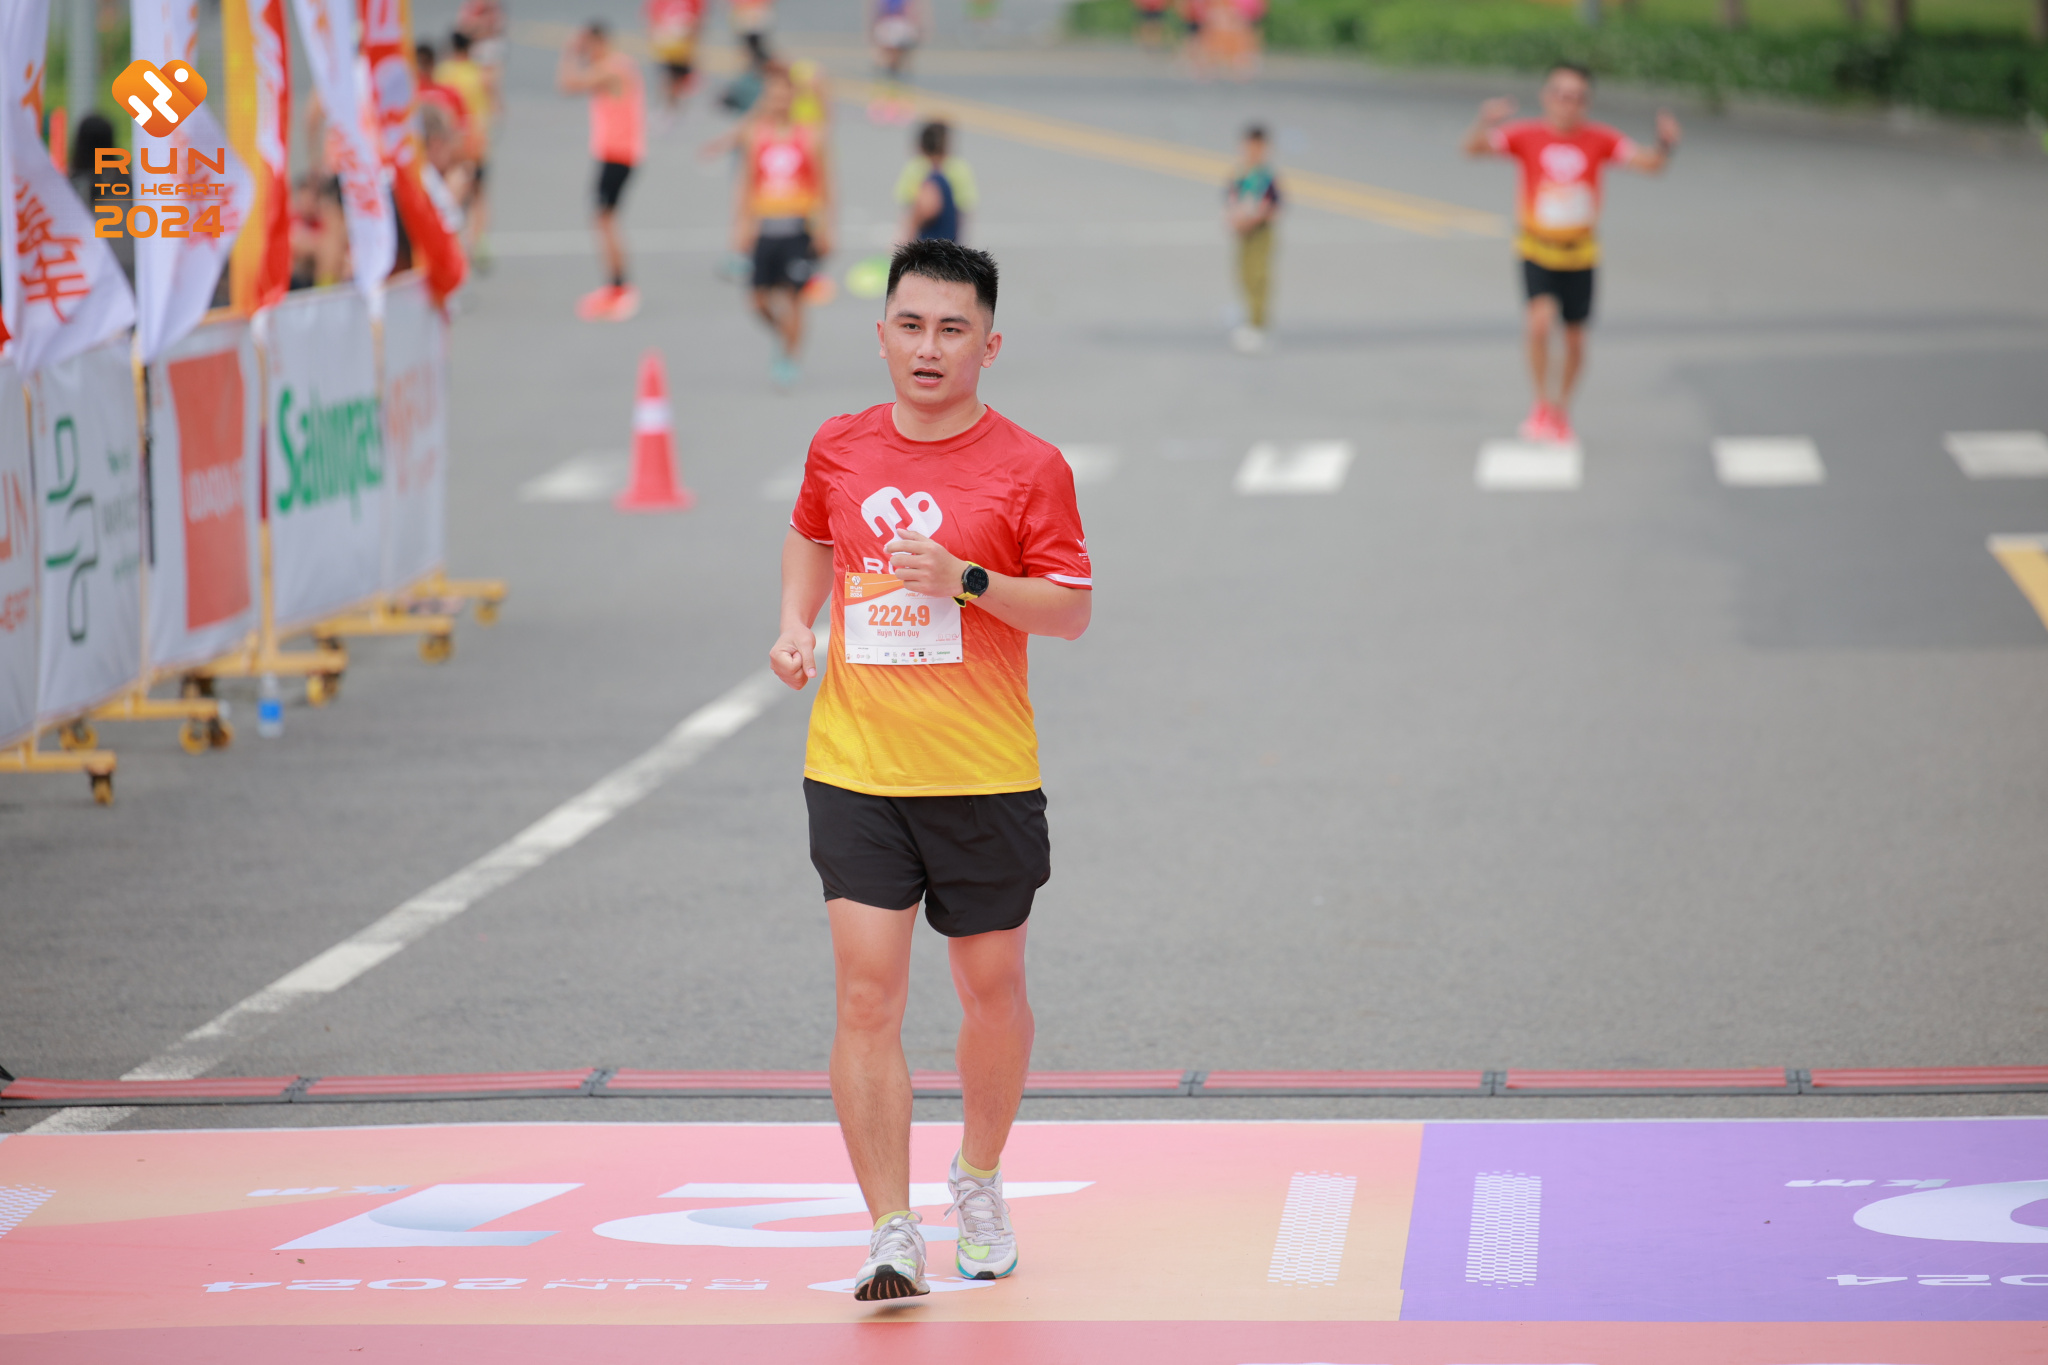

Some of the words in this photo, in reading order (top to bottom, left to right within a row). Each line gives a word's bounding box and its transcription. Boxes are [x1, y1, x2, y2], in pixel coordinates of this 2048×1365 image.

[868, 604, 930, 626] 22249
[270, 1181, 1097, 1250] 21
[202, 1277, 528, 1292] 2024
[543, 1282, 769, 1291] RUN
